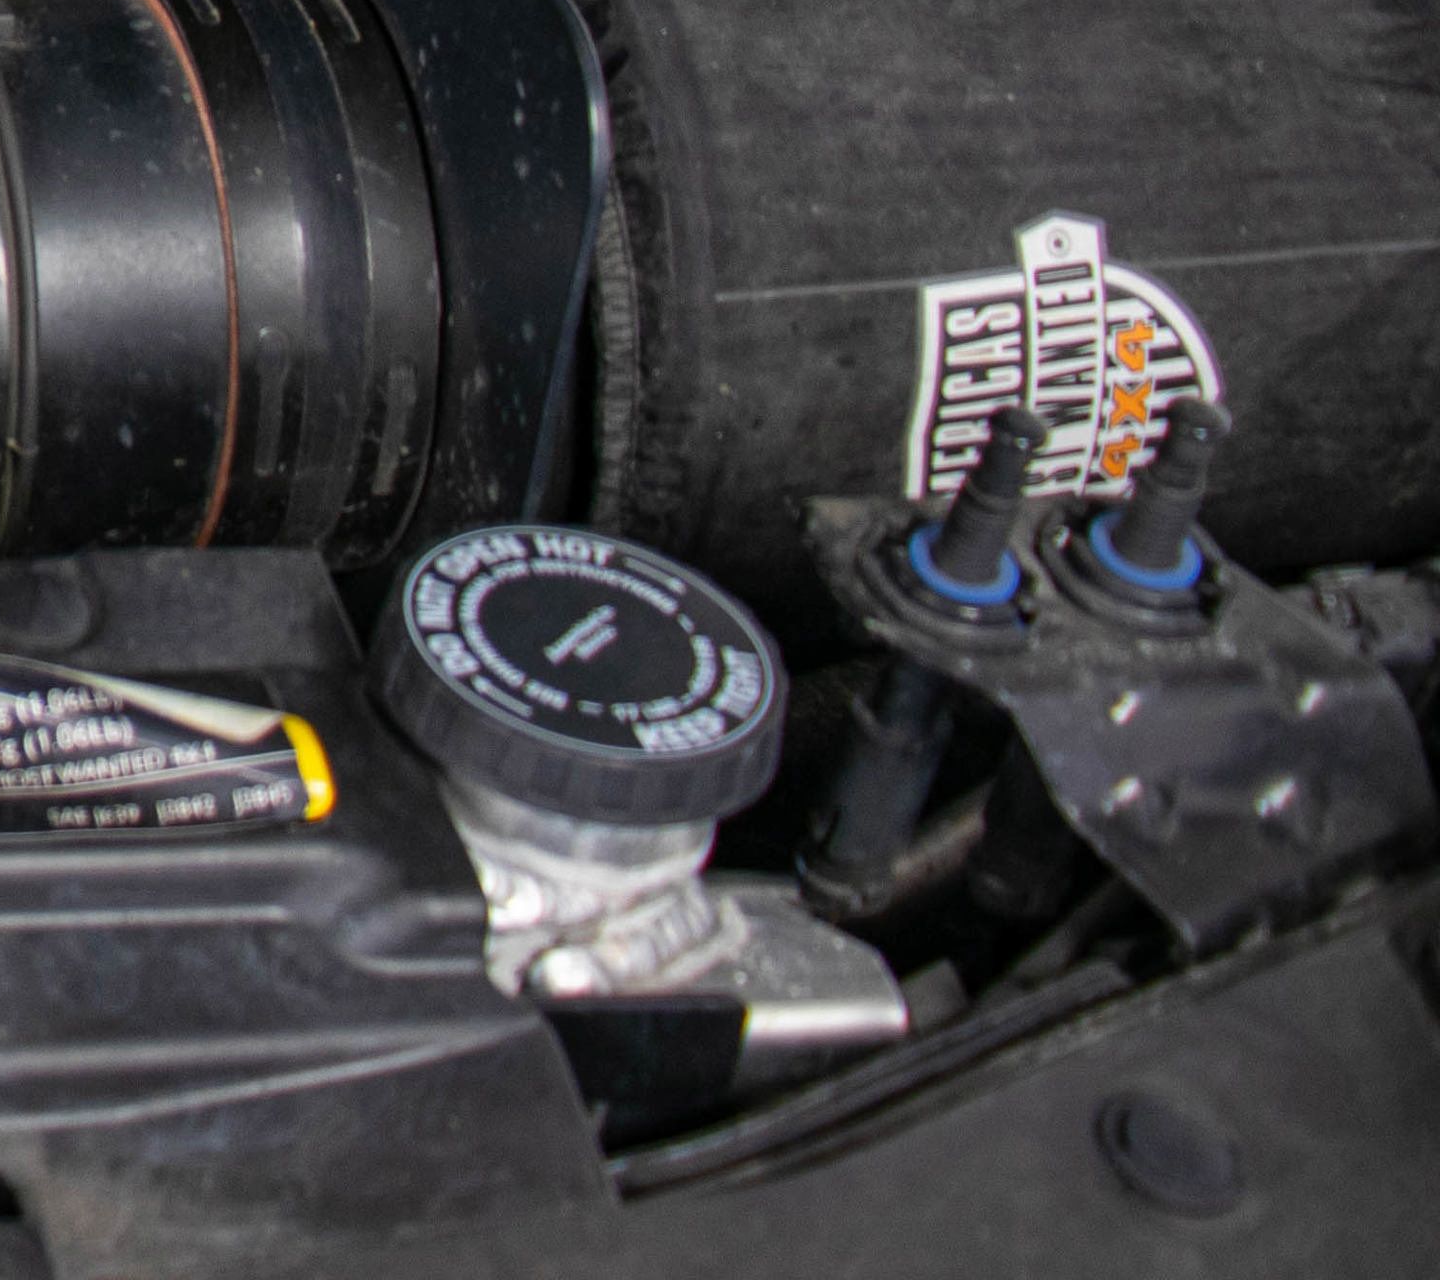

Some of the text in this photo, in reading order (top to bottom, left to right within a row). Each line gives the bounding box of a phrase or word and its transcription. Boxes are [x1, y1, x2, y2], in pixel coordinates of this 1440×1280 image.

[1100, 319, 1157, 480] 4X4
[434, 533, 530, 582] OPEN
[533, 532, 616, 566] HOT
[426, 633, 478, 678] DO
[47, 805, 91, 829] SAE
